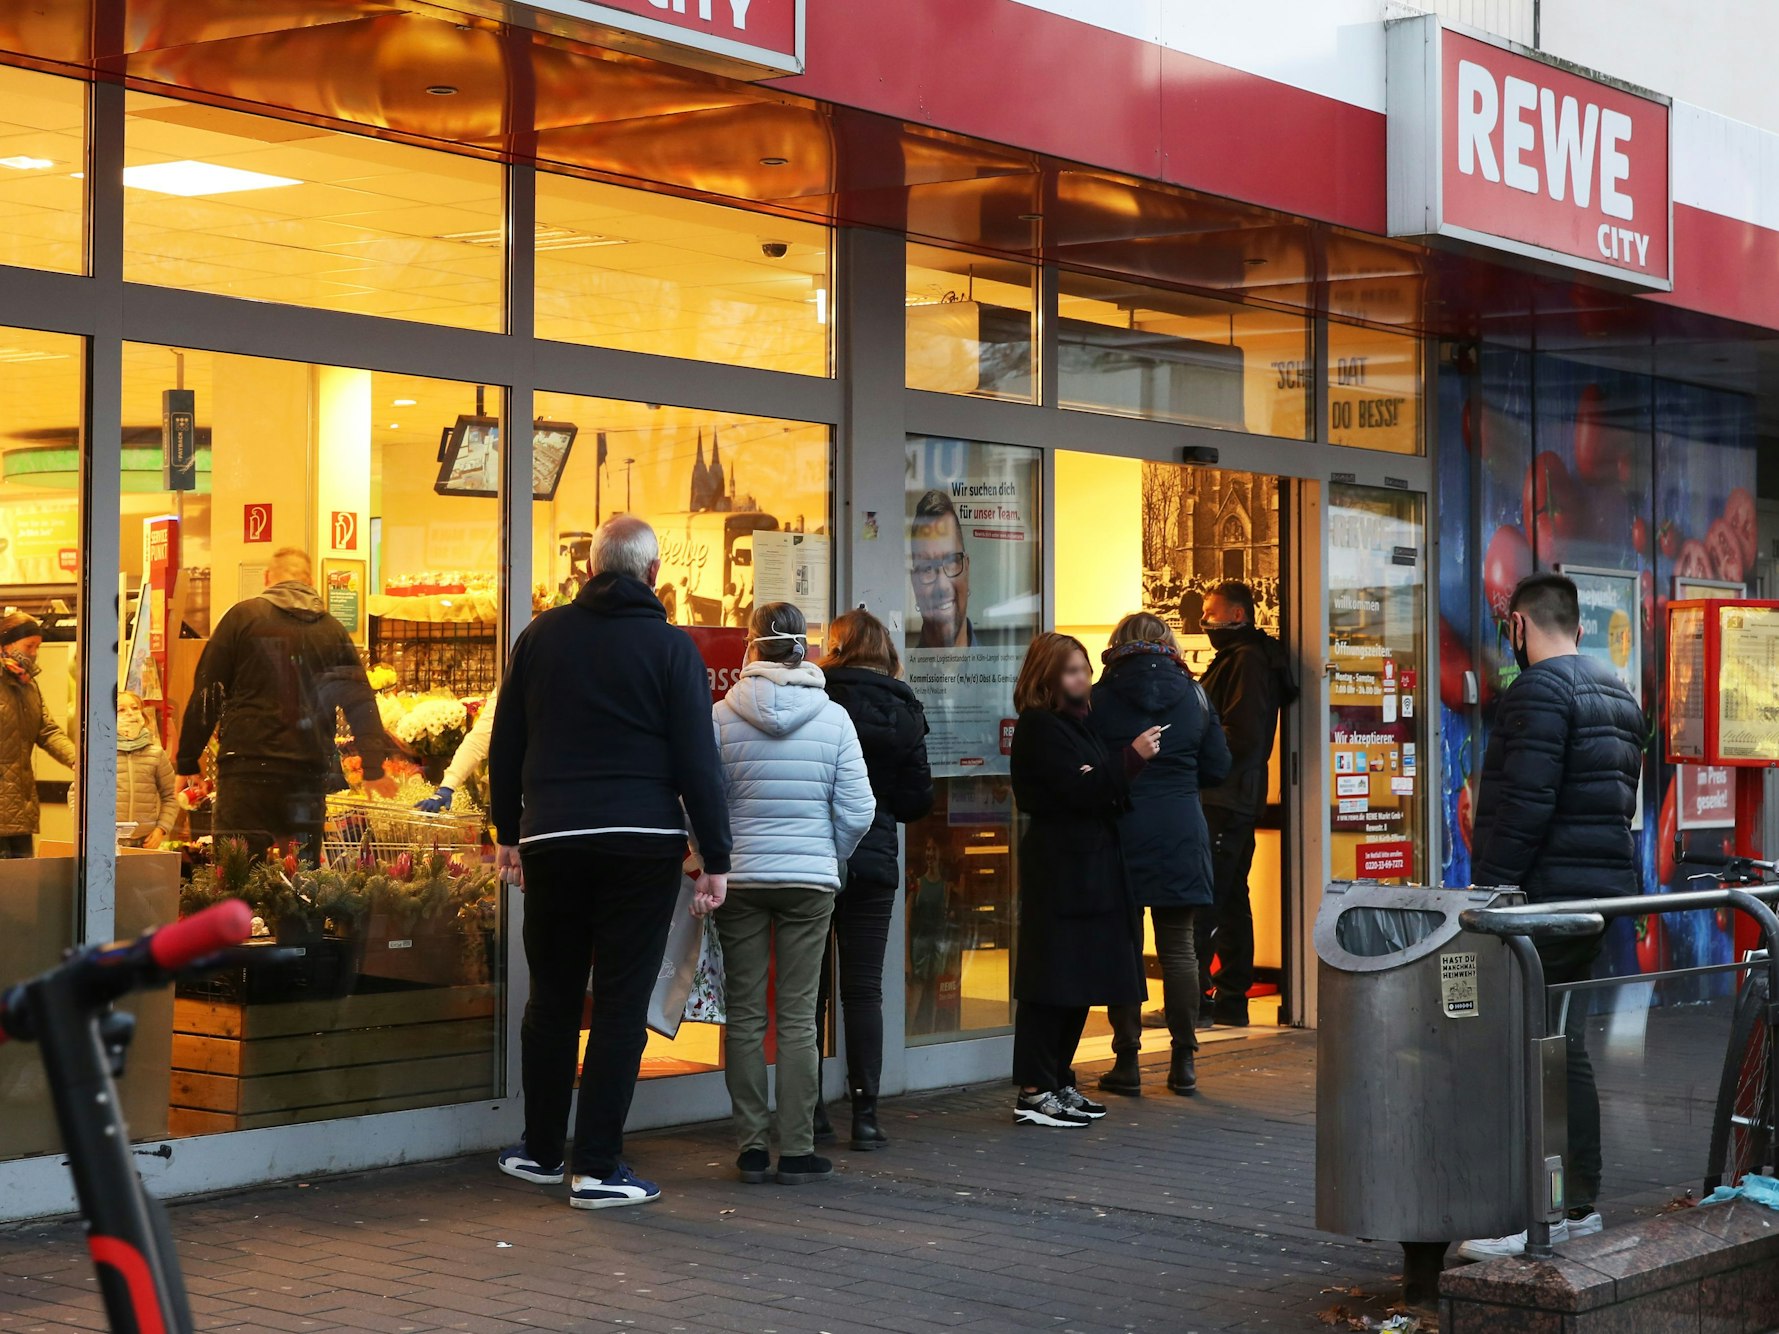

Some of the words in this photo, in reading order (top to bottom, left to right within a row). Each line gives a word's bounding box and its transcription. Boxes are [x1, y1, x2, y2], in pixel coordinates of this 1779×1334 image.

[1458, 59, 1633, 221] REWE
[1597, 223, 1649, 266] CITY
[1338, 357, 1367, 385] DAT
[1333, 401, 1350, 429] DO
[952, 482, 968, 497] Wir
[969, 482, 997, 496] suchen
[999, 482, 1015, 496] dich
[960, 505, 972, 519] für
[973, 508, 995, 519] unser
[997, 506, 1020, 520] Team.
[1334, 595, 1380, 612] willkommen
[1580, 612, 1598, 635] ion
[1334, 639, 1393, 660] Öffnungszeiten:
[707, 666, 741, 691] ass
[1003, 727, 1015, 736] RE
[1334, 731, 1348, 744] Wir
[1349, 730, 1395, 748] akzeptieren:
[1697, 767, 1707, 785] im
[1708, 765, 1727, 784] Preis
[1696, 789, 1728, 816] gesenkt!
[1442, 956, 1463, 964] HAST
[1465, 955, 1475, 963] DU
[1442, 963, 1476, 972] MANCHMAL
[1442, 970, 1476, 979] HEIMWEH?
